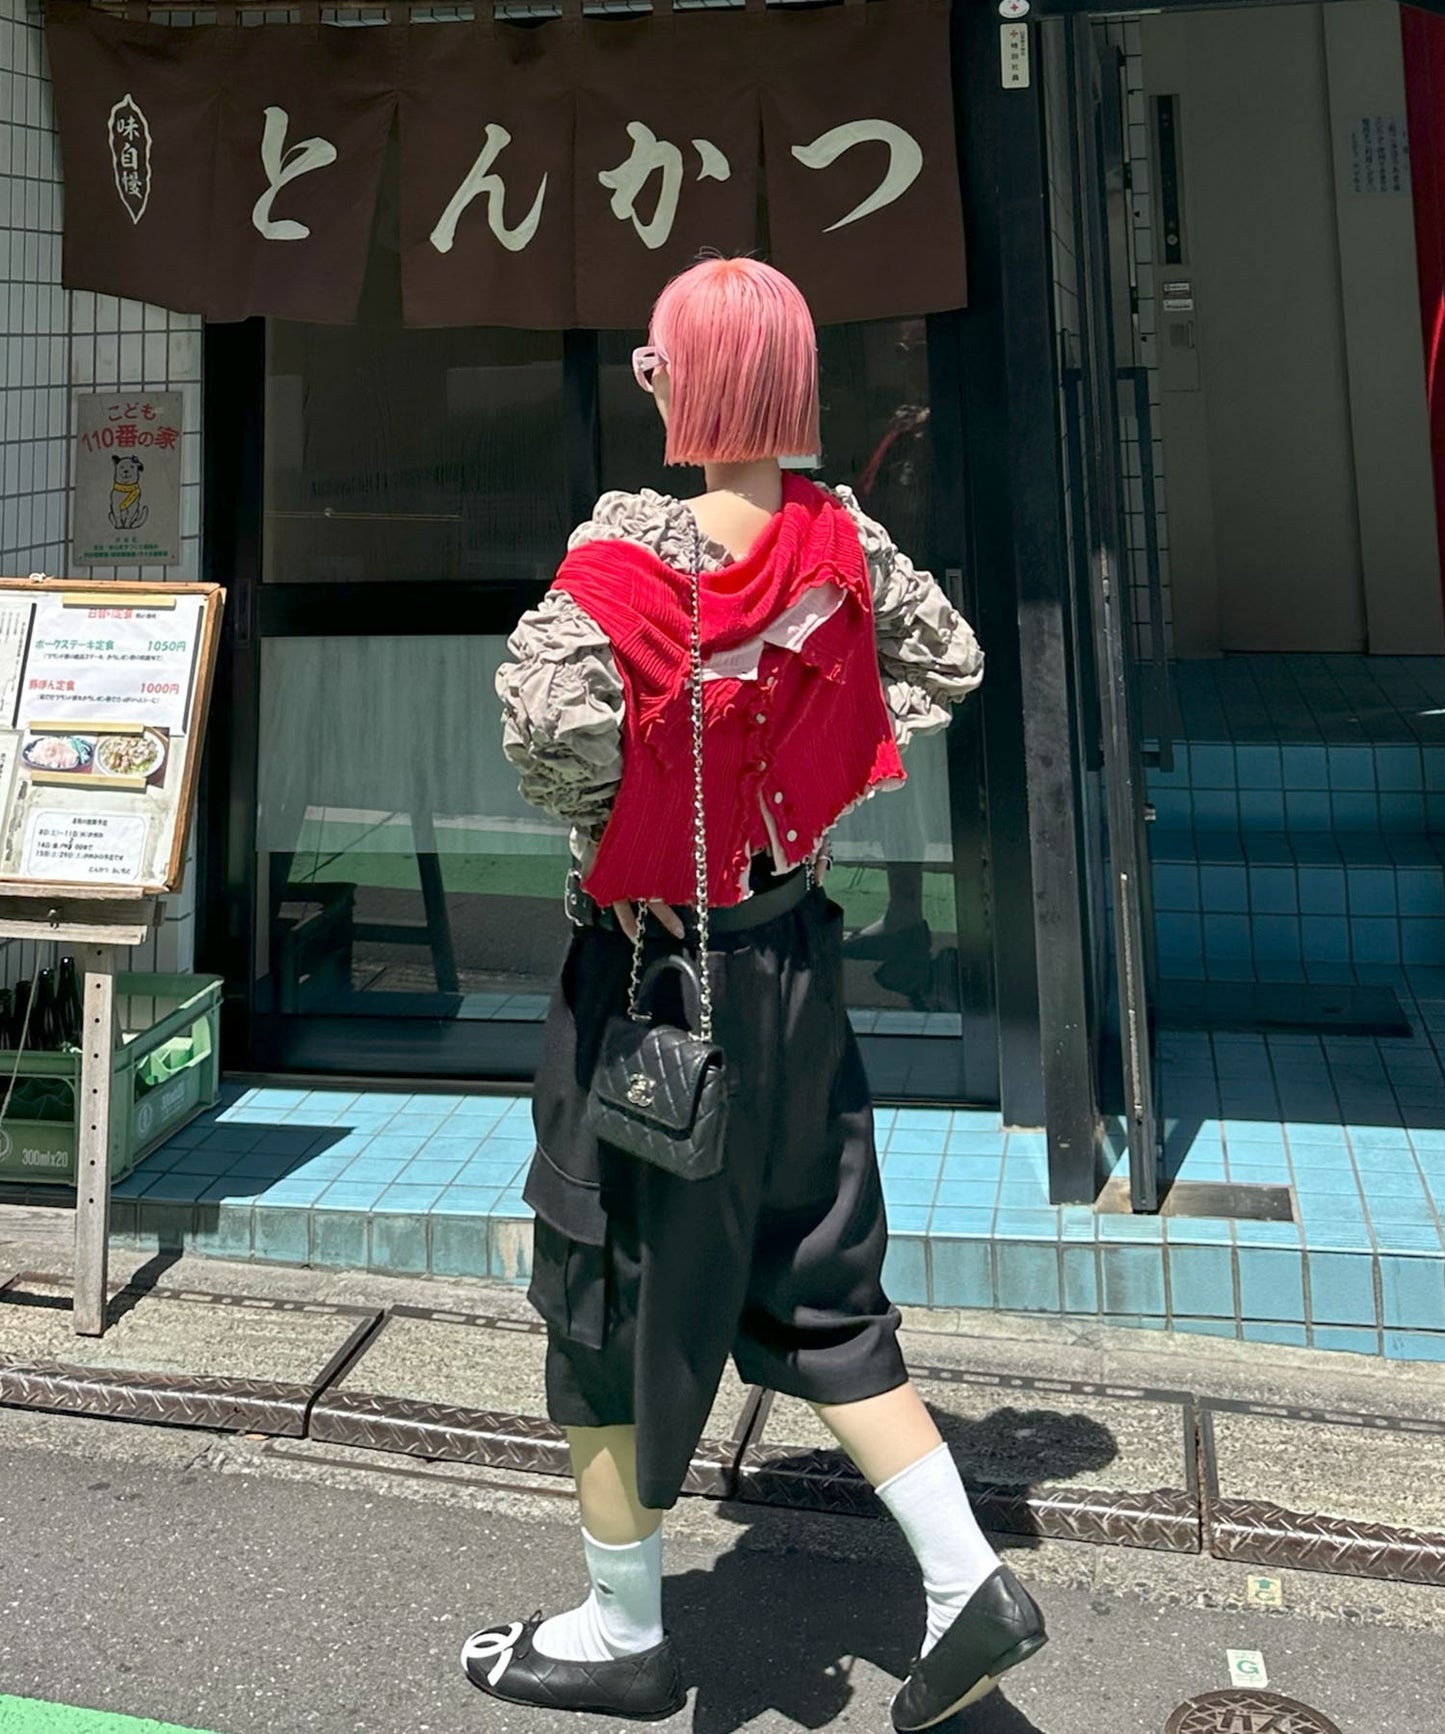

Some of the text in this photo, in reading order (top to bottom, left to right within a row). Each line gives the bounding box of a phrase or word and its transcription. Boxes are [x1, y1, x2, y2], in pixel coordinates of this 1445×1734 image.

[116, 115, 143, 199] 味自慢
[252, 105, 924, 252] とんかつ
[107, 402, 156, 421] こども
[82, 424, 179, 452] 110番の家
[34, 639, 187, 652] ポークステーキ定食 1050円
[140, 682, 180, 694] 1000円
[1237, 1660, 1259, 1674] G
